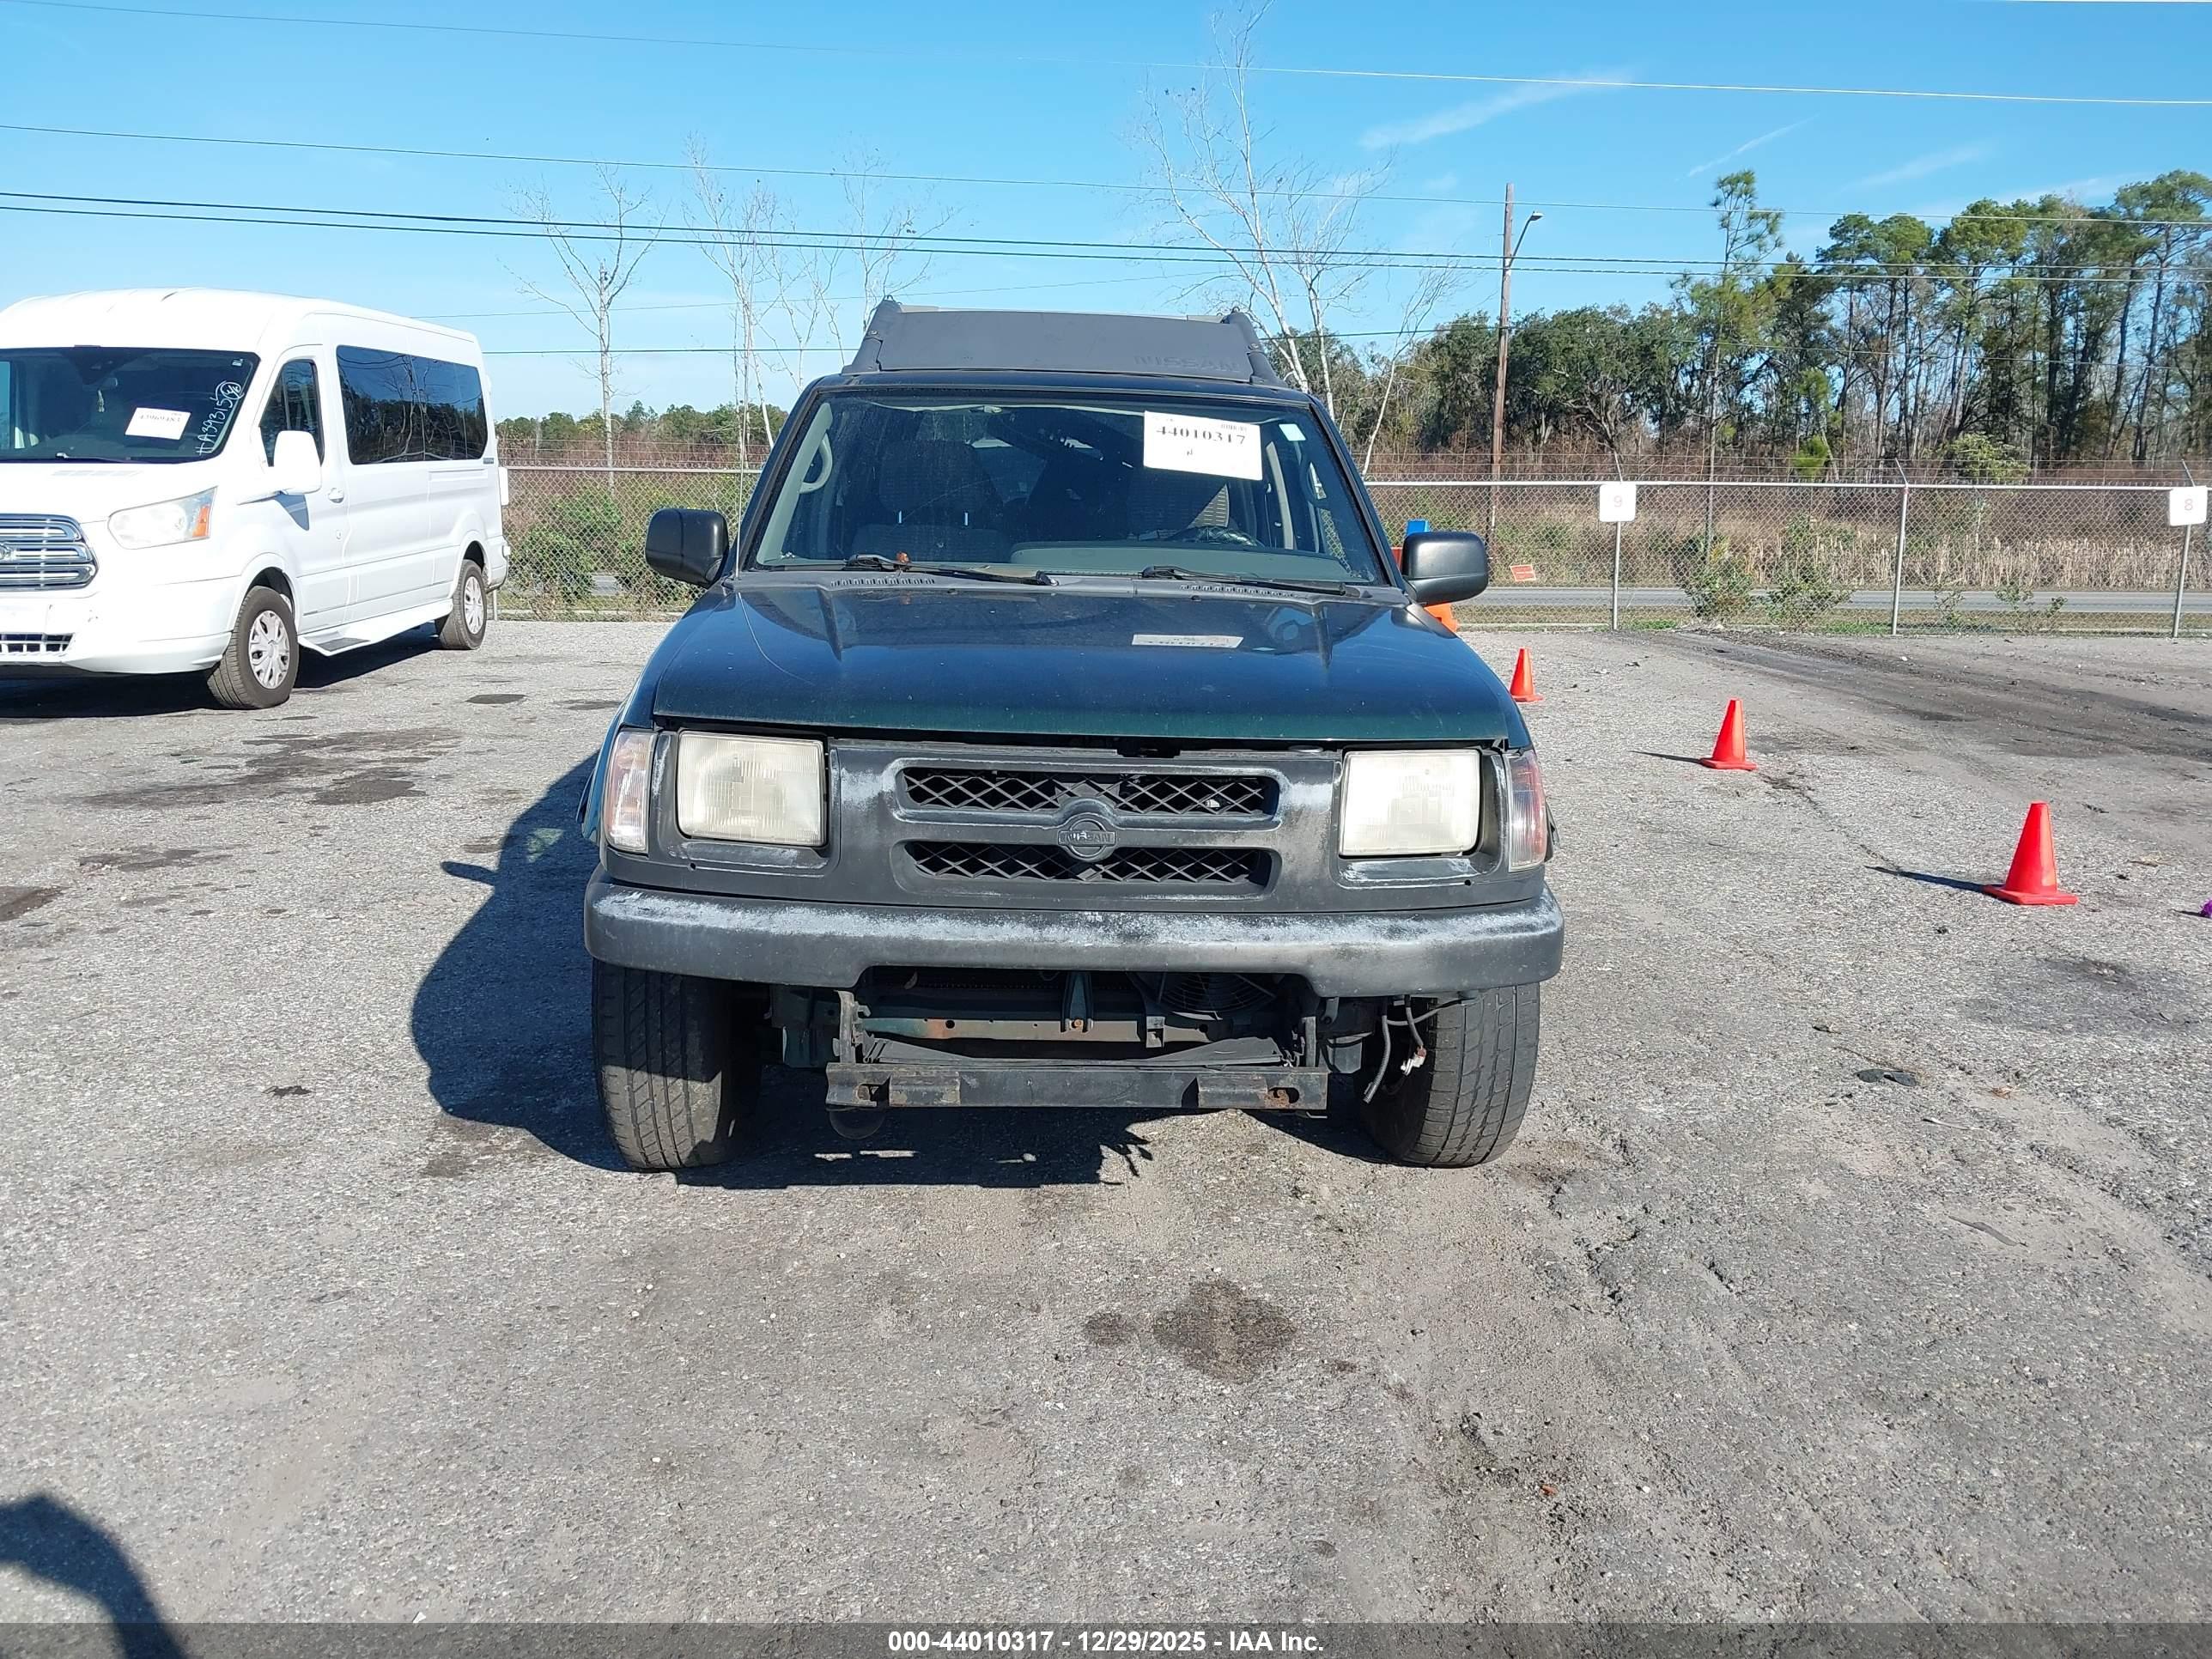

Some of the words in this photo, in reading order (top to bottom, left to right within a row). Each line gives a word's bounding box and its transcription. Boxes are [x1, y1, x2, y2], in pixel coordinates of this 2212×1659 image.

[1156, 426, 1246, 445] 44010317
[1613, 495, 1622, 507] 9
[2184, 498, 2193, 511] 8
